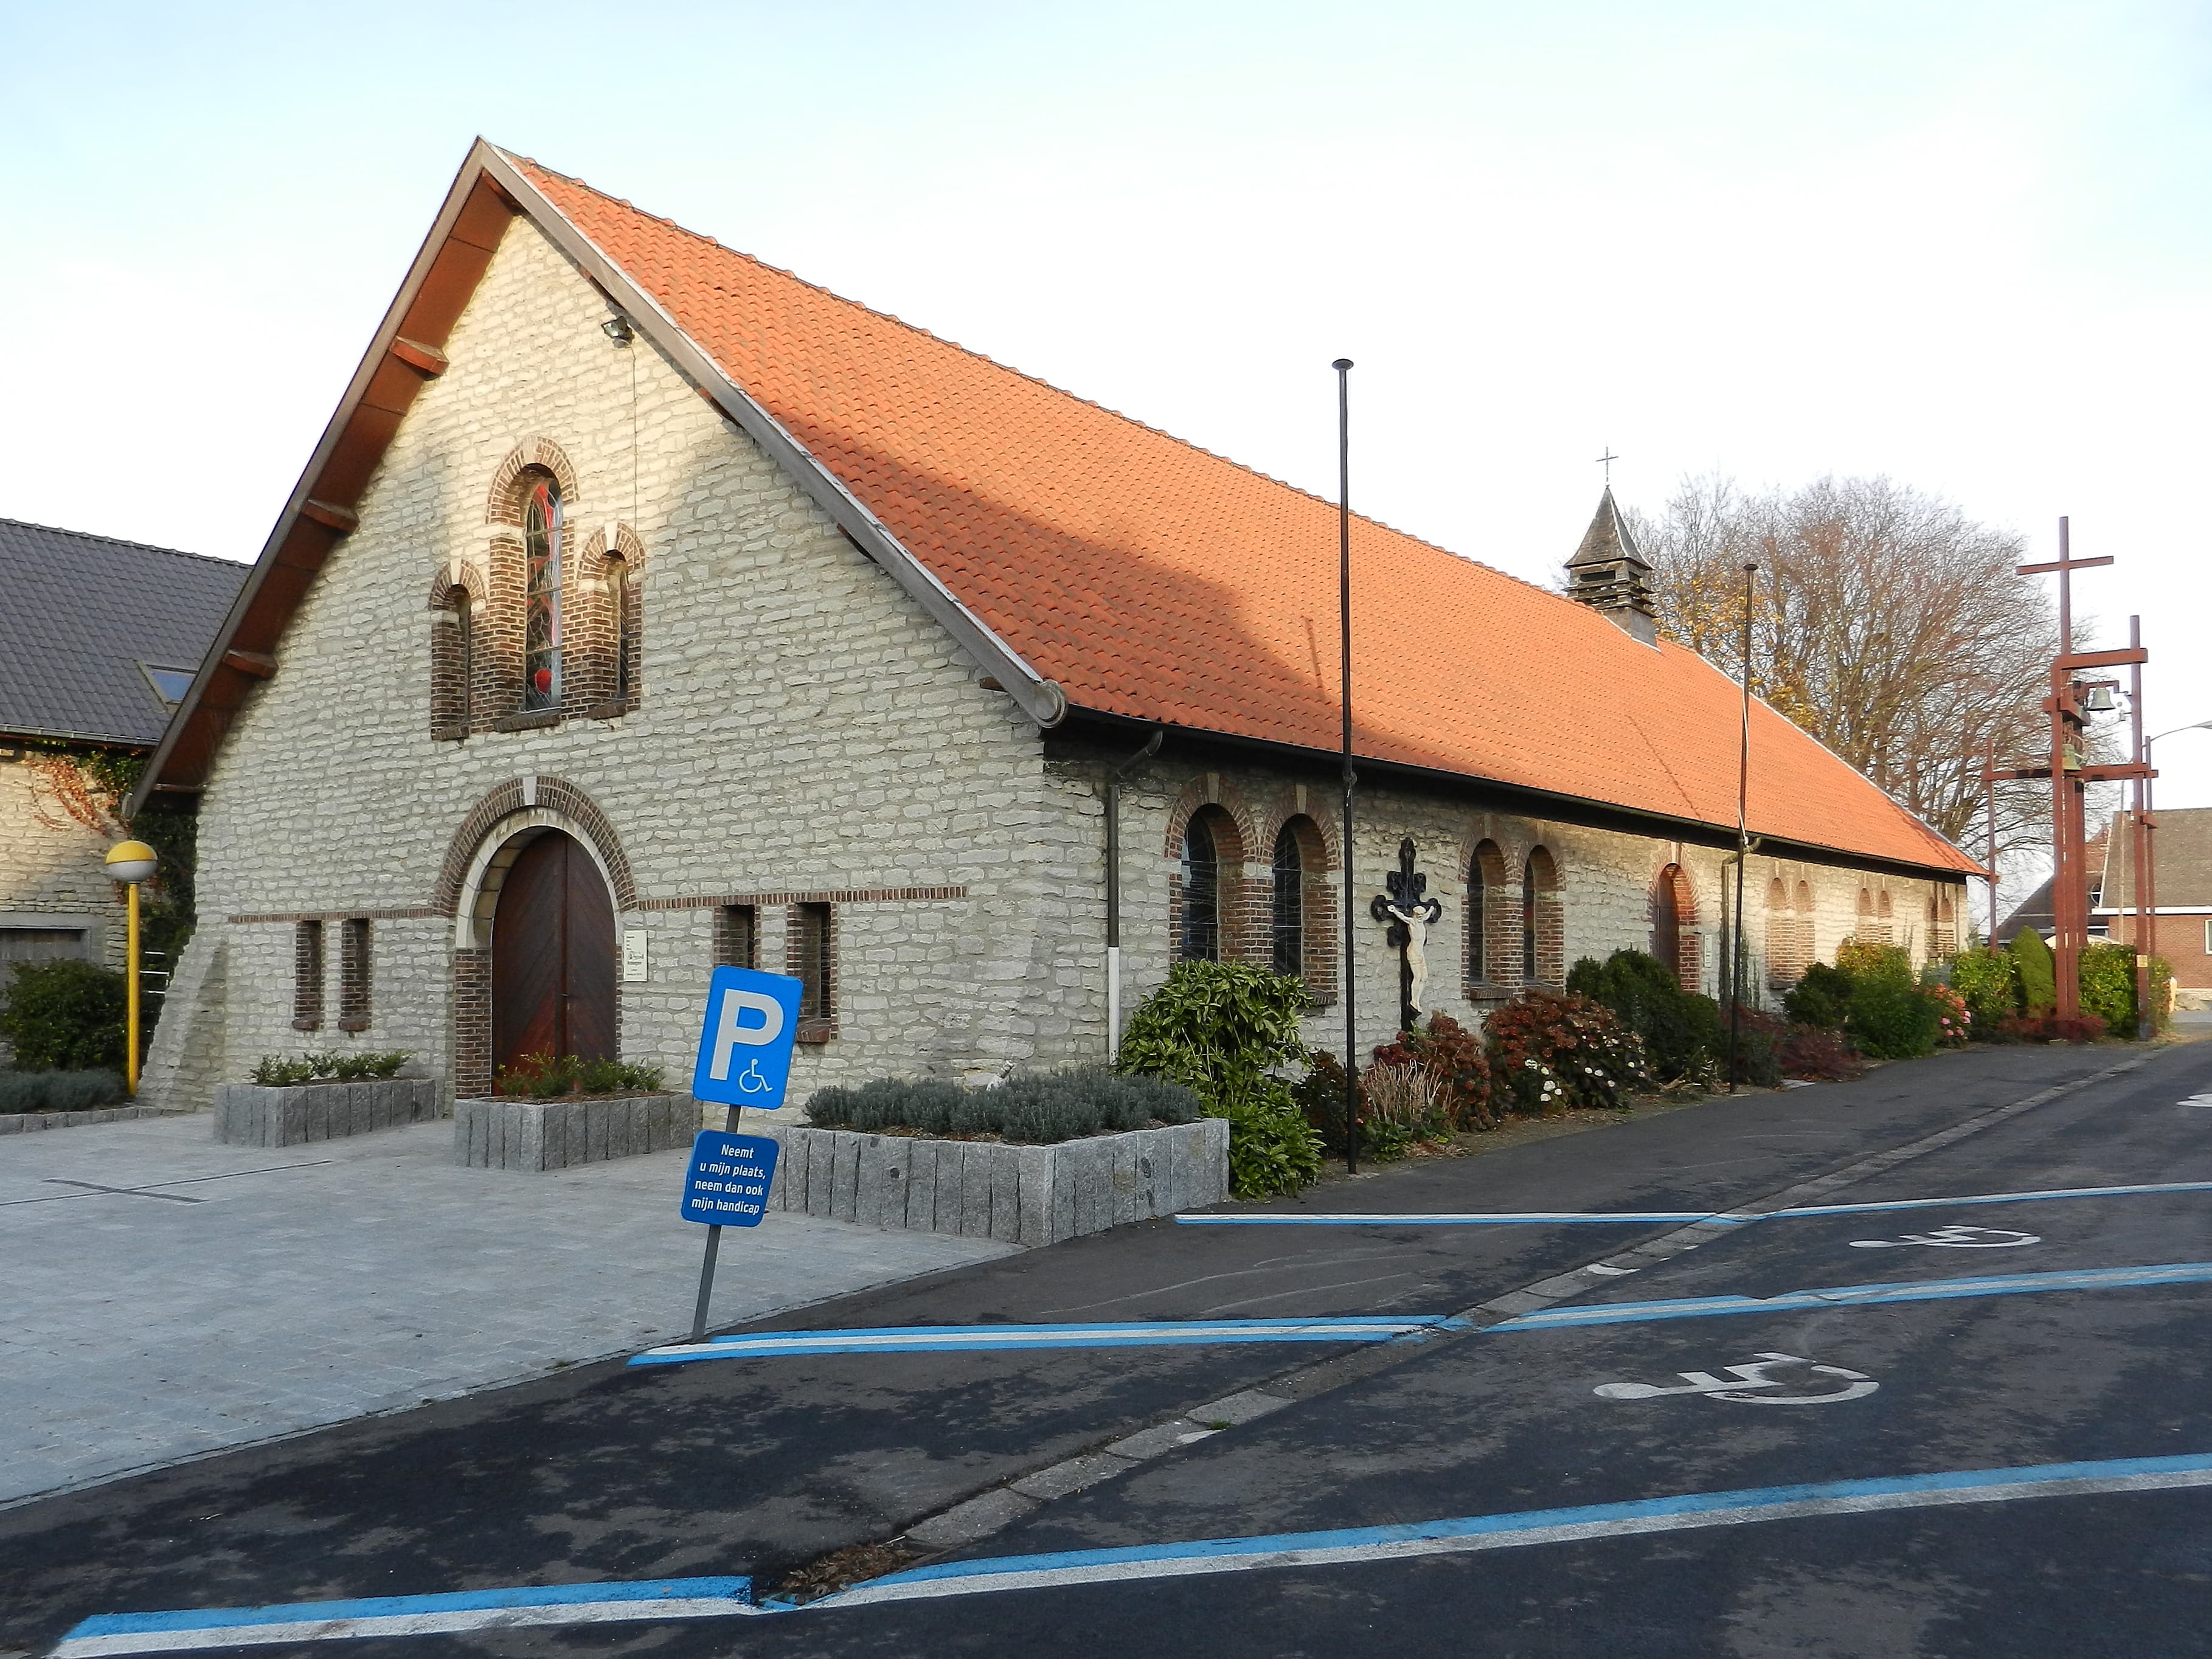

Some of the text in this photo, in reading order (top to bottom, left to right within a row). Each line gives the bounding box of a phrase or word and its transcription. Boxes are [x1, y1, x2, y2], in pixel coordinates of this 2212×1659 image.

[710, 988, 785, 1081] P
[721, 1144, 754, 1159] Neemt
[699, 1162, 766, 1180] u mijn plaats,
[695, 1180, 764, 1196] neem dan ook
[692, 1197, 760, 1216] mijn handicap
